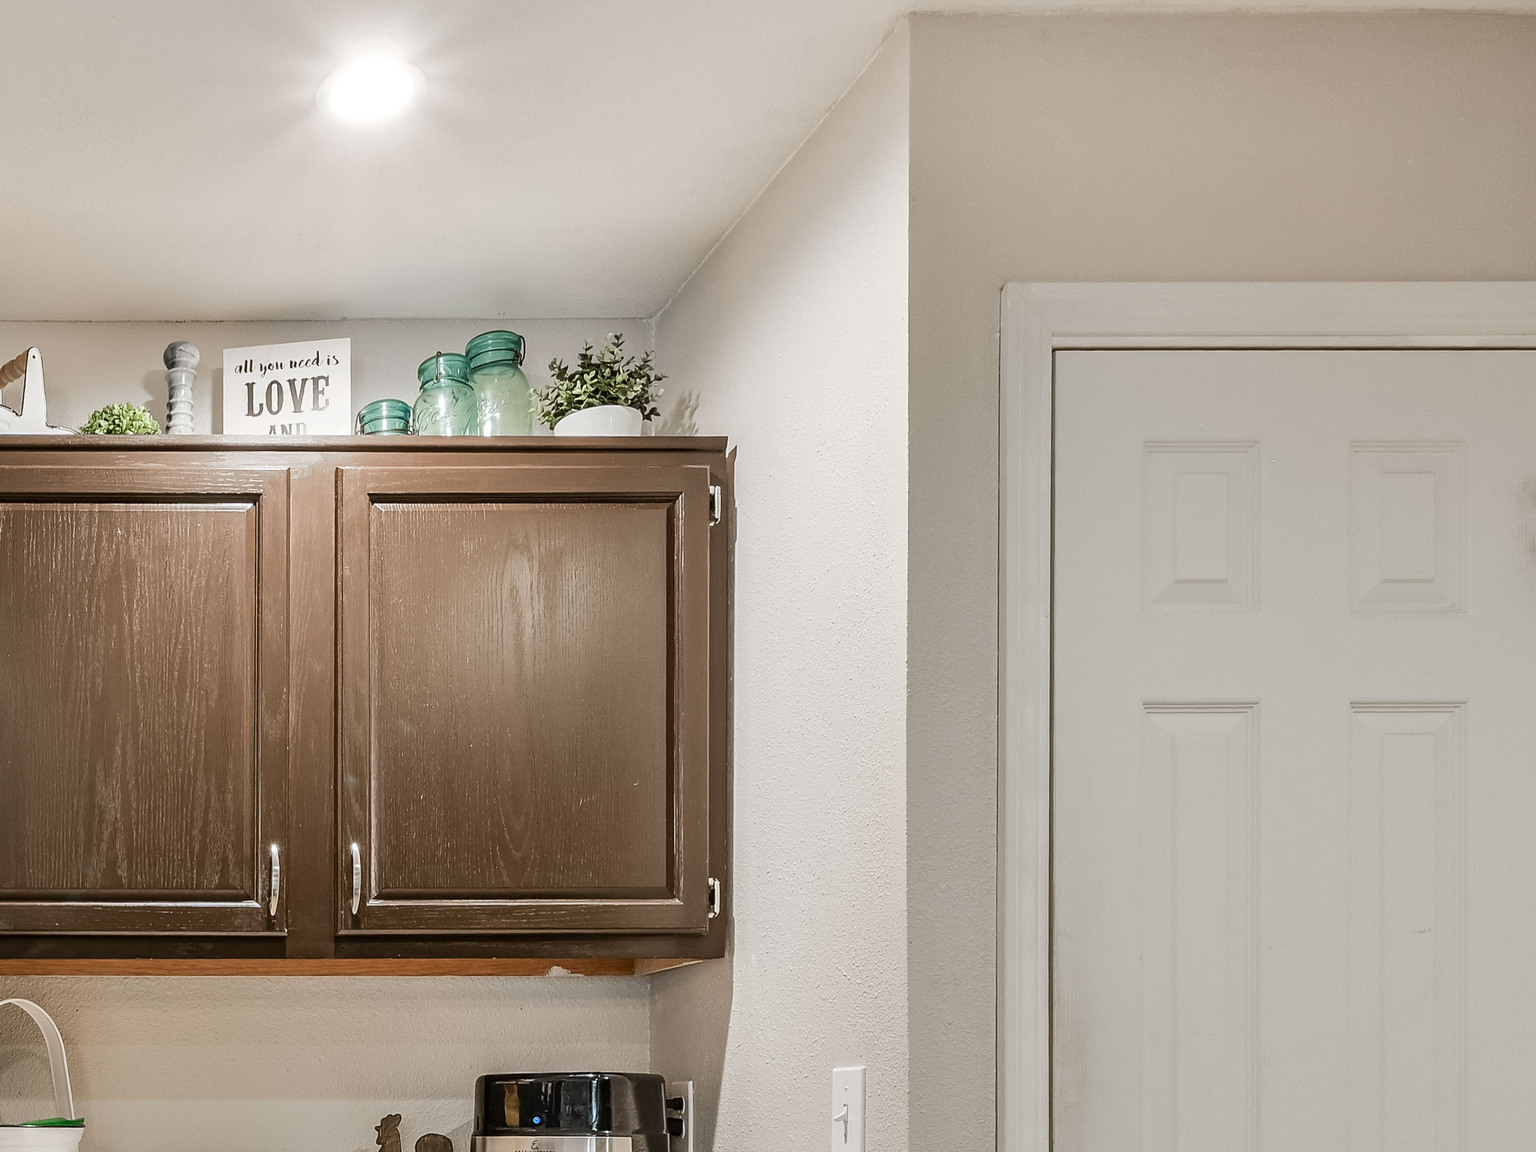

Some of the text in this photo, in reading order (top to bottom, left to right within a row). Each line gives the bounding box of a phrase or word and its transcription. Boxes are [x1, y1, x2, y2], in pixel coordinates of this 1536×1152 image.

[234, 350, 339, 378] all you need is
[244, 374, 330, 417] LOVE
